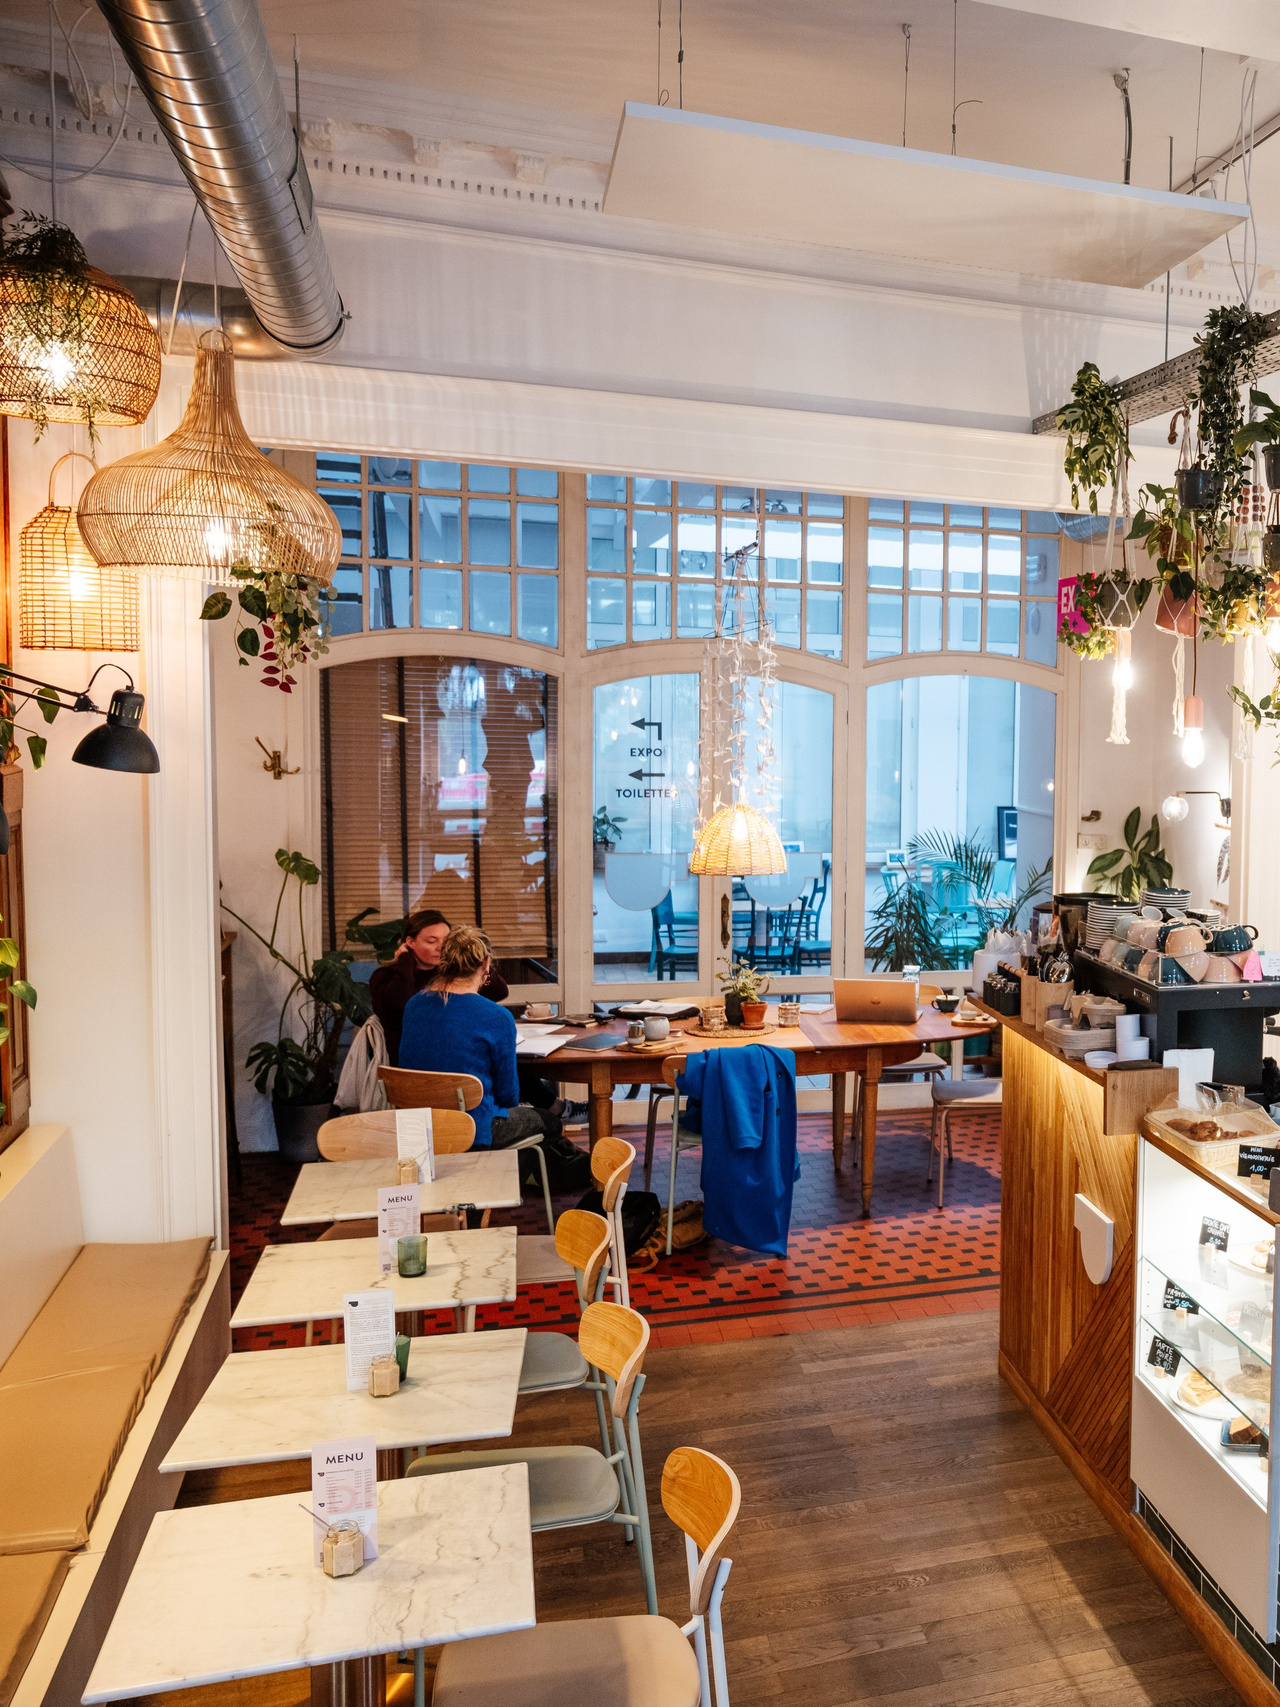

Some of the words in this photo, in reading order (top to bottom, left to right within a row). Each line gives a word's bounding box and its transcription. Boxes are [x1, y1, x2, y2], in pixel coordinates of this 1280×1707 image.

[630, 748, 663, 757] EXPO
[387, 1195, 413, 1204] MENU
[1155, 1340, 1174, 1356] TARTE
[325, 1452, 364, 1465] MENU
